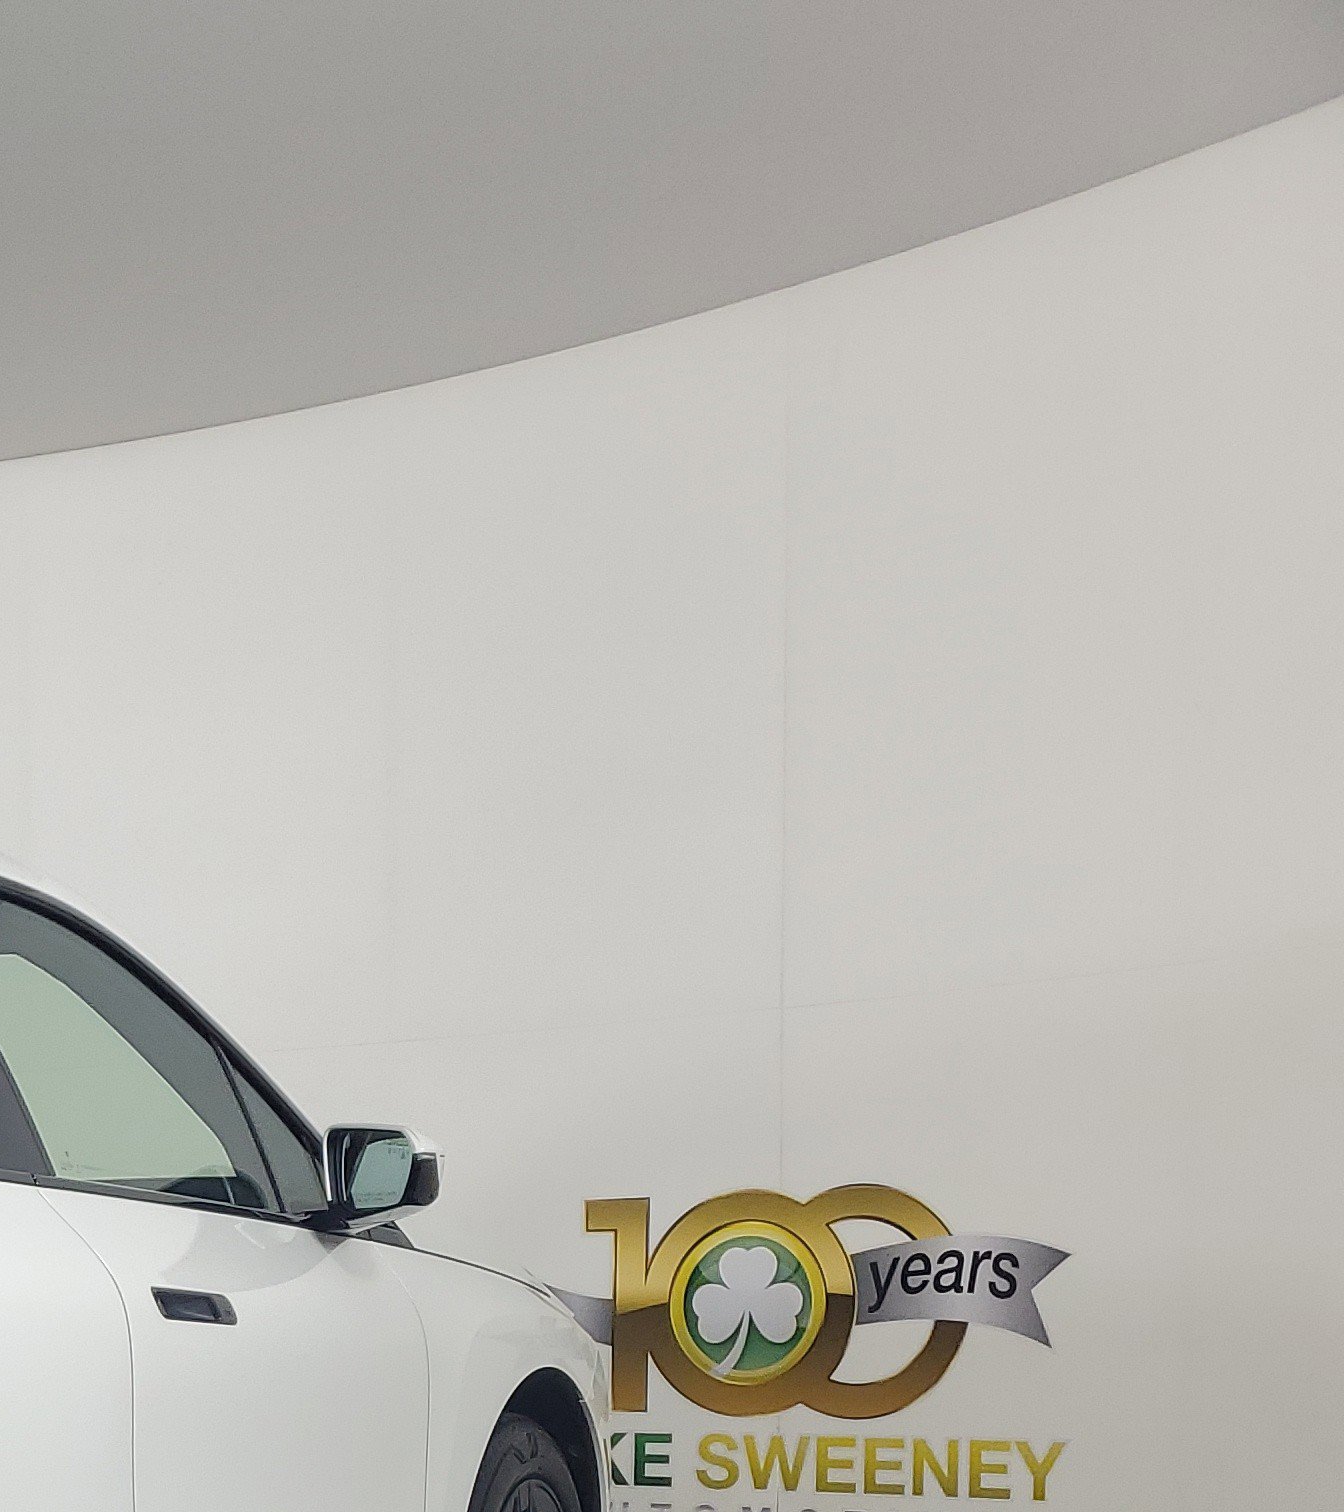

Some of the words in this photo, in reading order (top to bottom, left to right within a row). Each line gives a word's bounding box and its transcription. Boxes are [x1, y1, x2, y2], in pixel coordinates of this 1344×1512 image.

[584, 1183, 969, 1420] 100
[866, 1248, 1019, 1314] years
[696, 1432, 1067, 1502] SWEENEY
